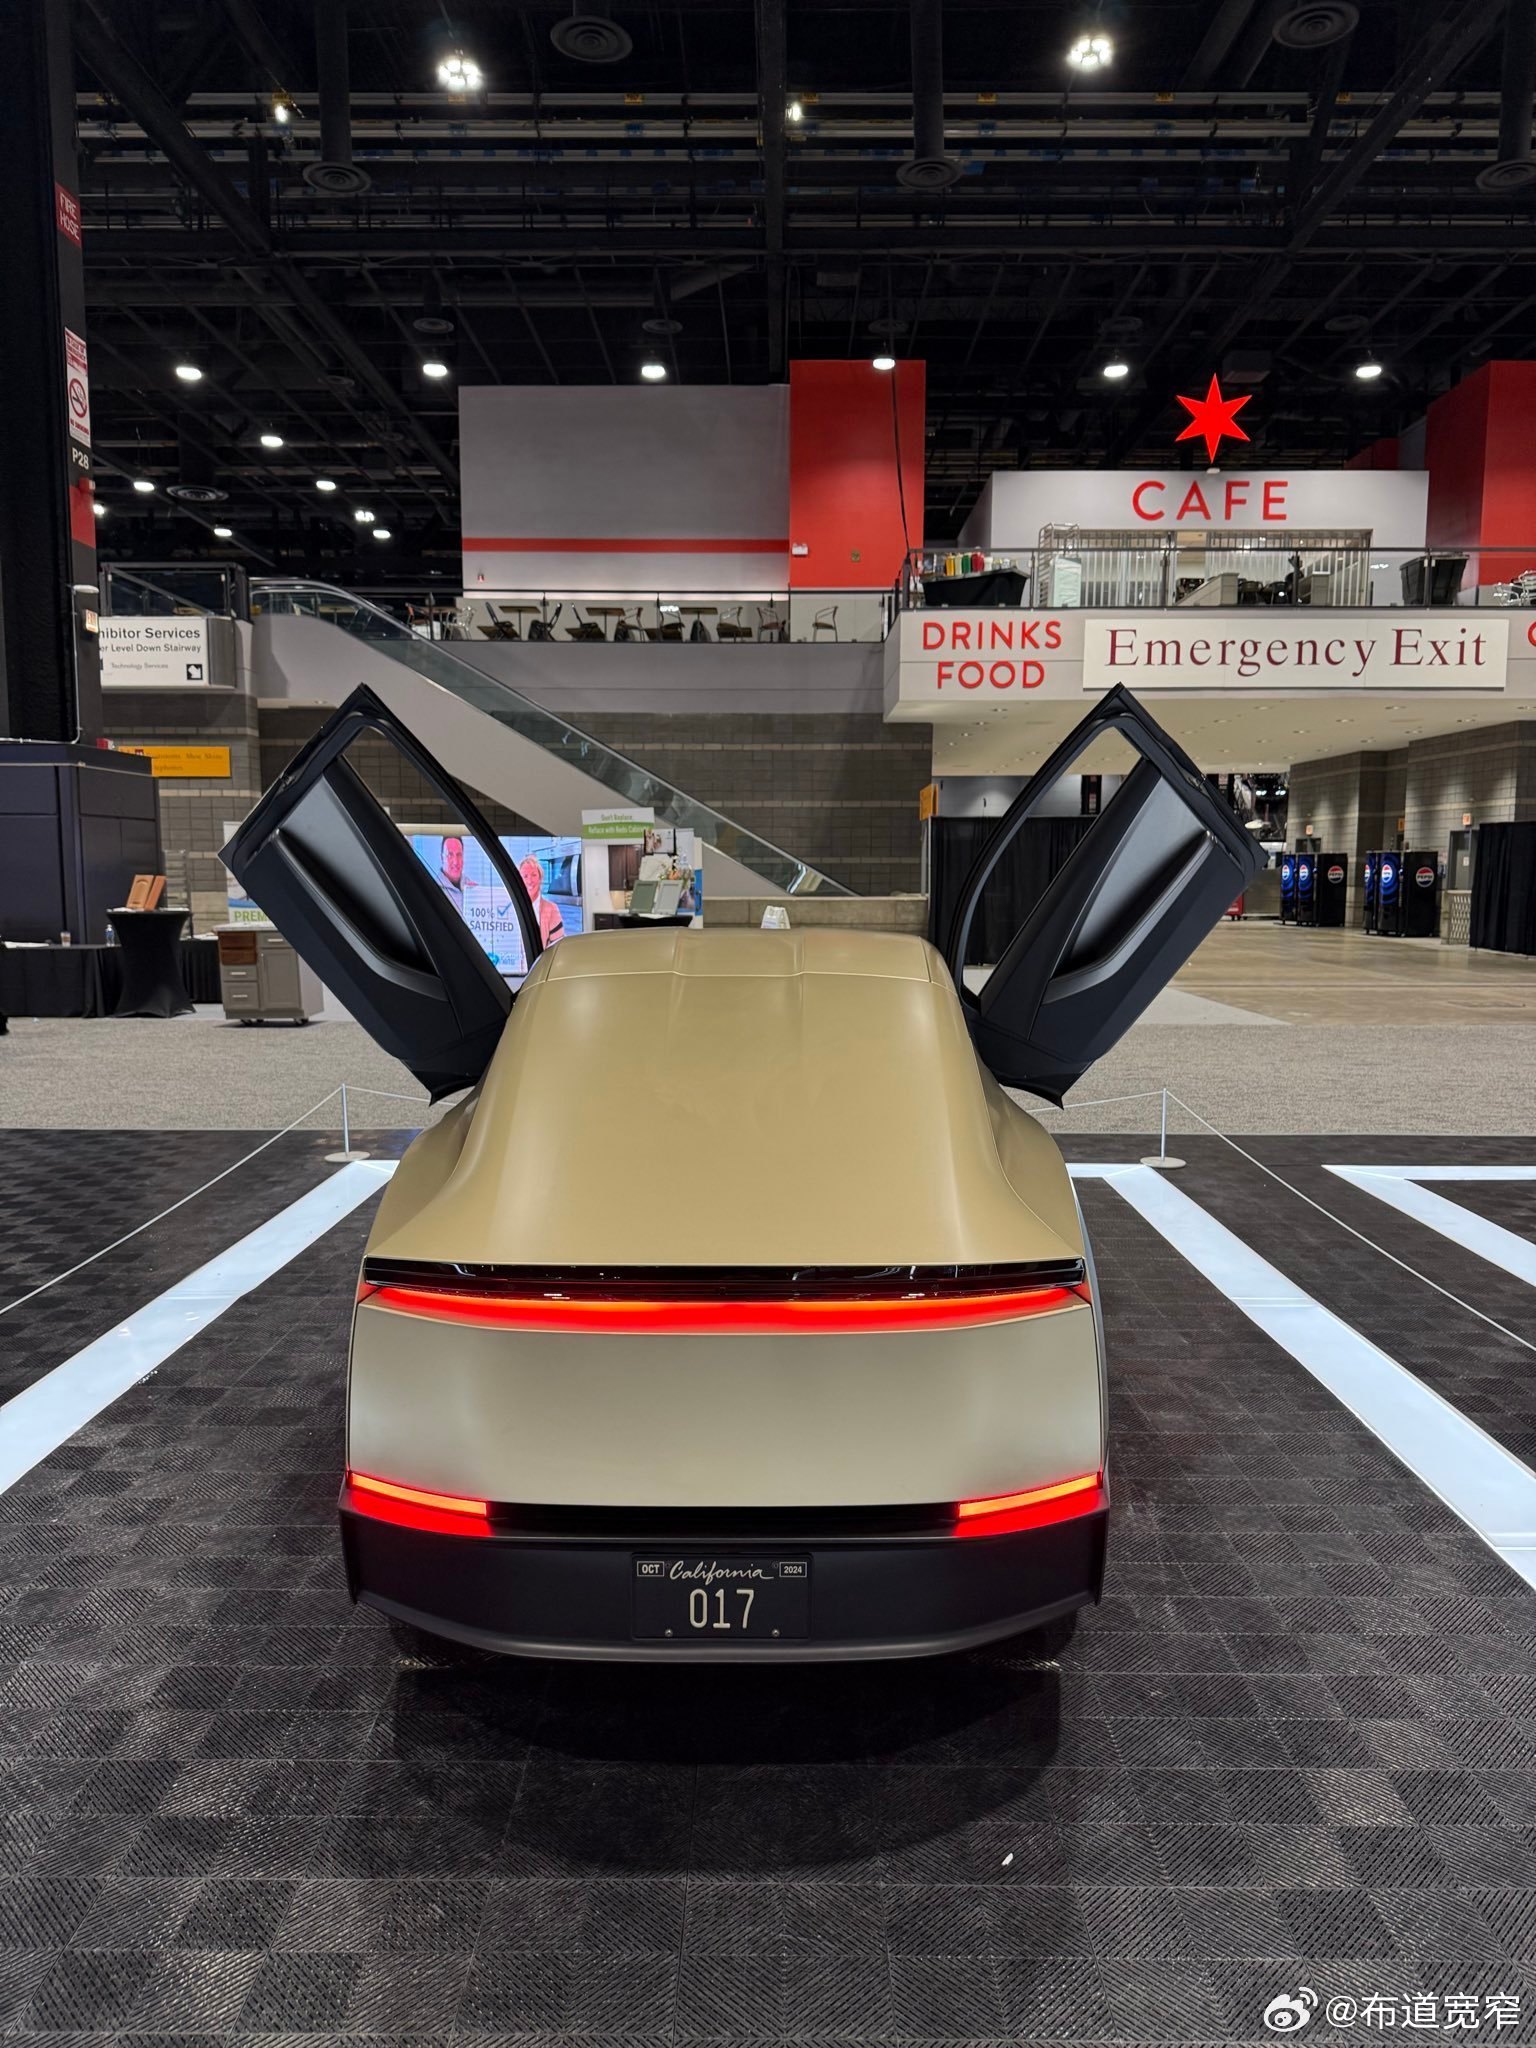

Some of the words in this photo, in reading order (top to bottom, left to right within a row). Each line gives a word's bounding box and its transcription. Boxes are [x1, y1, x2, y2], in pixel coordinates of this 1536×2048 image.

[60, 192, 77, 220] FIRE
[60, 210, 80, 240] HOSE
[72, 447, 89, 470] P28
[1132, 481, 1289, 521] CAFE
[145, 627, 201, 639] Services
[923, 621, 1062, 650] DRINKS
[111, 644, 134, 652] Level
[136, 644, 162, 652] Down
[164, 643, 201, 654] Stairway
[1105, 629, 1377, 678] Emergency
[1390, 627, 1487, 668] Exit
[937, 661, 1046, 689] FOOD
[469, 920, 514, 932] SATISFIED
[470, 908, 495, 919] 100%
[641, 1564, 660, 1574] OCT
[669, 1560, 774, 1586] California
[783, 1566, 802, 1574] 2024
[689, 1588, 755, 1629] 017
